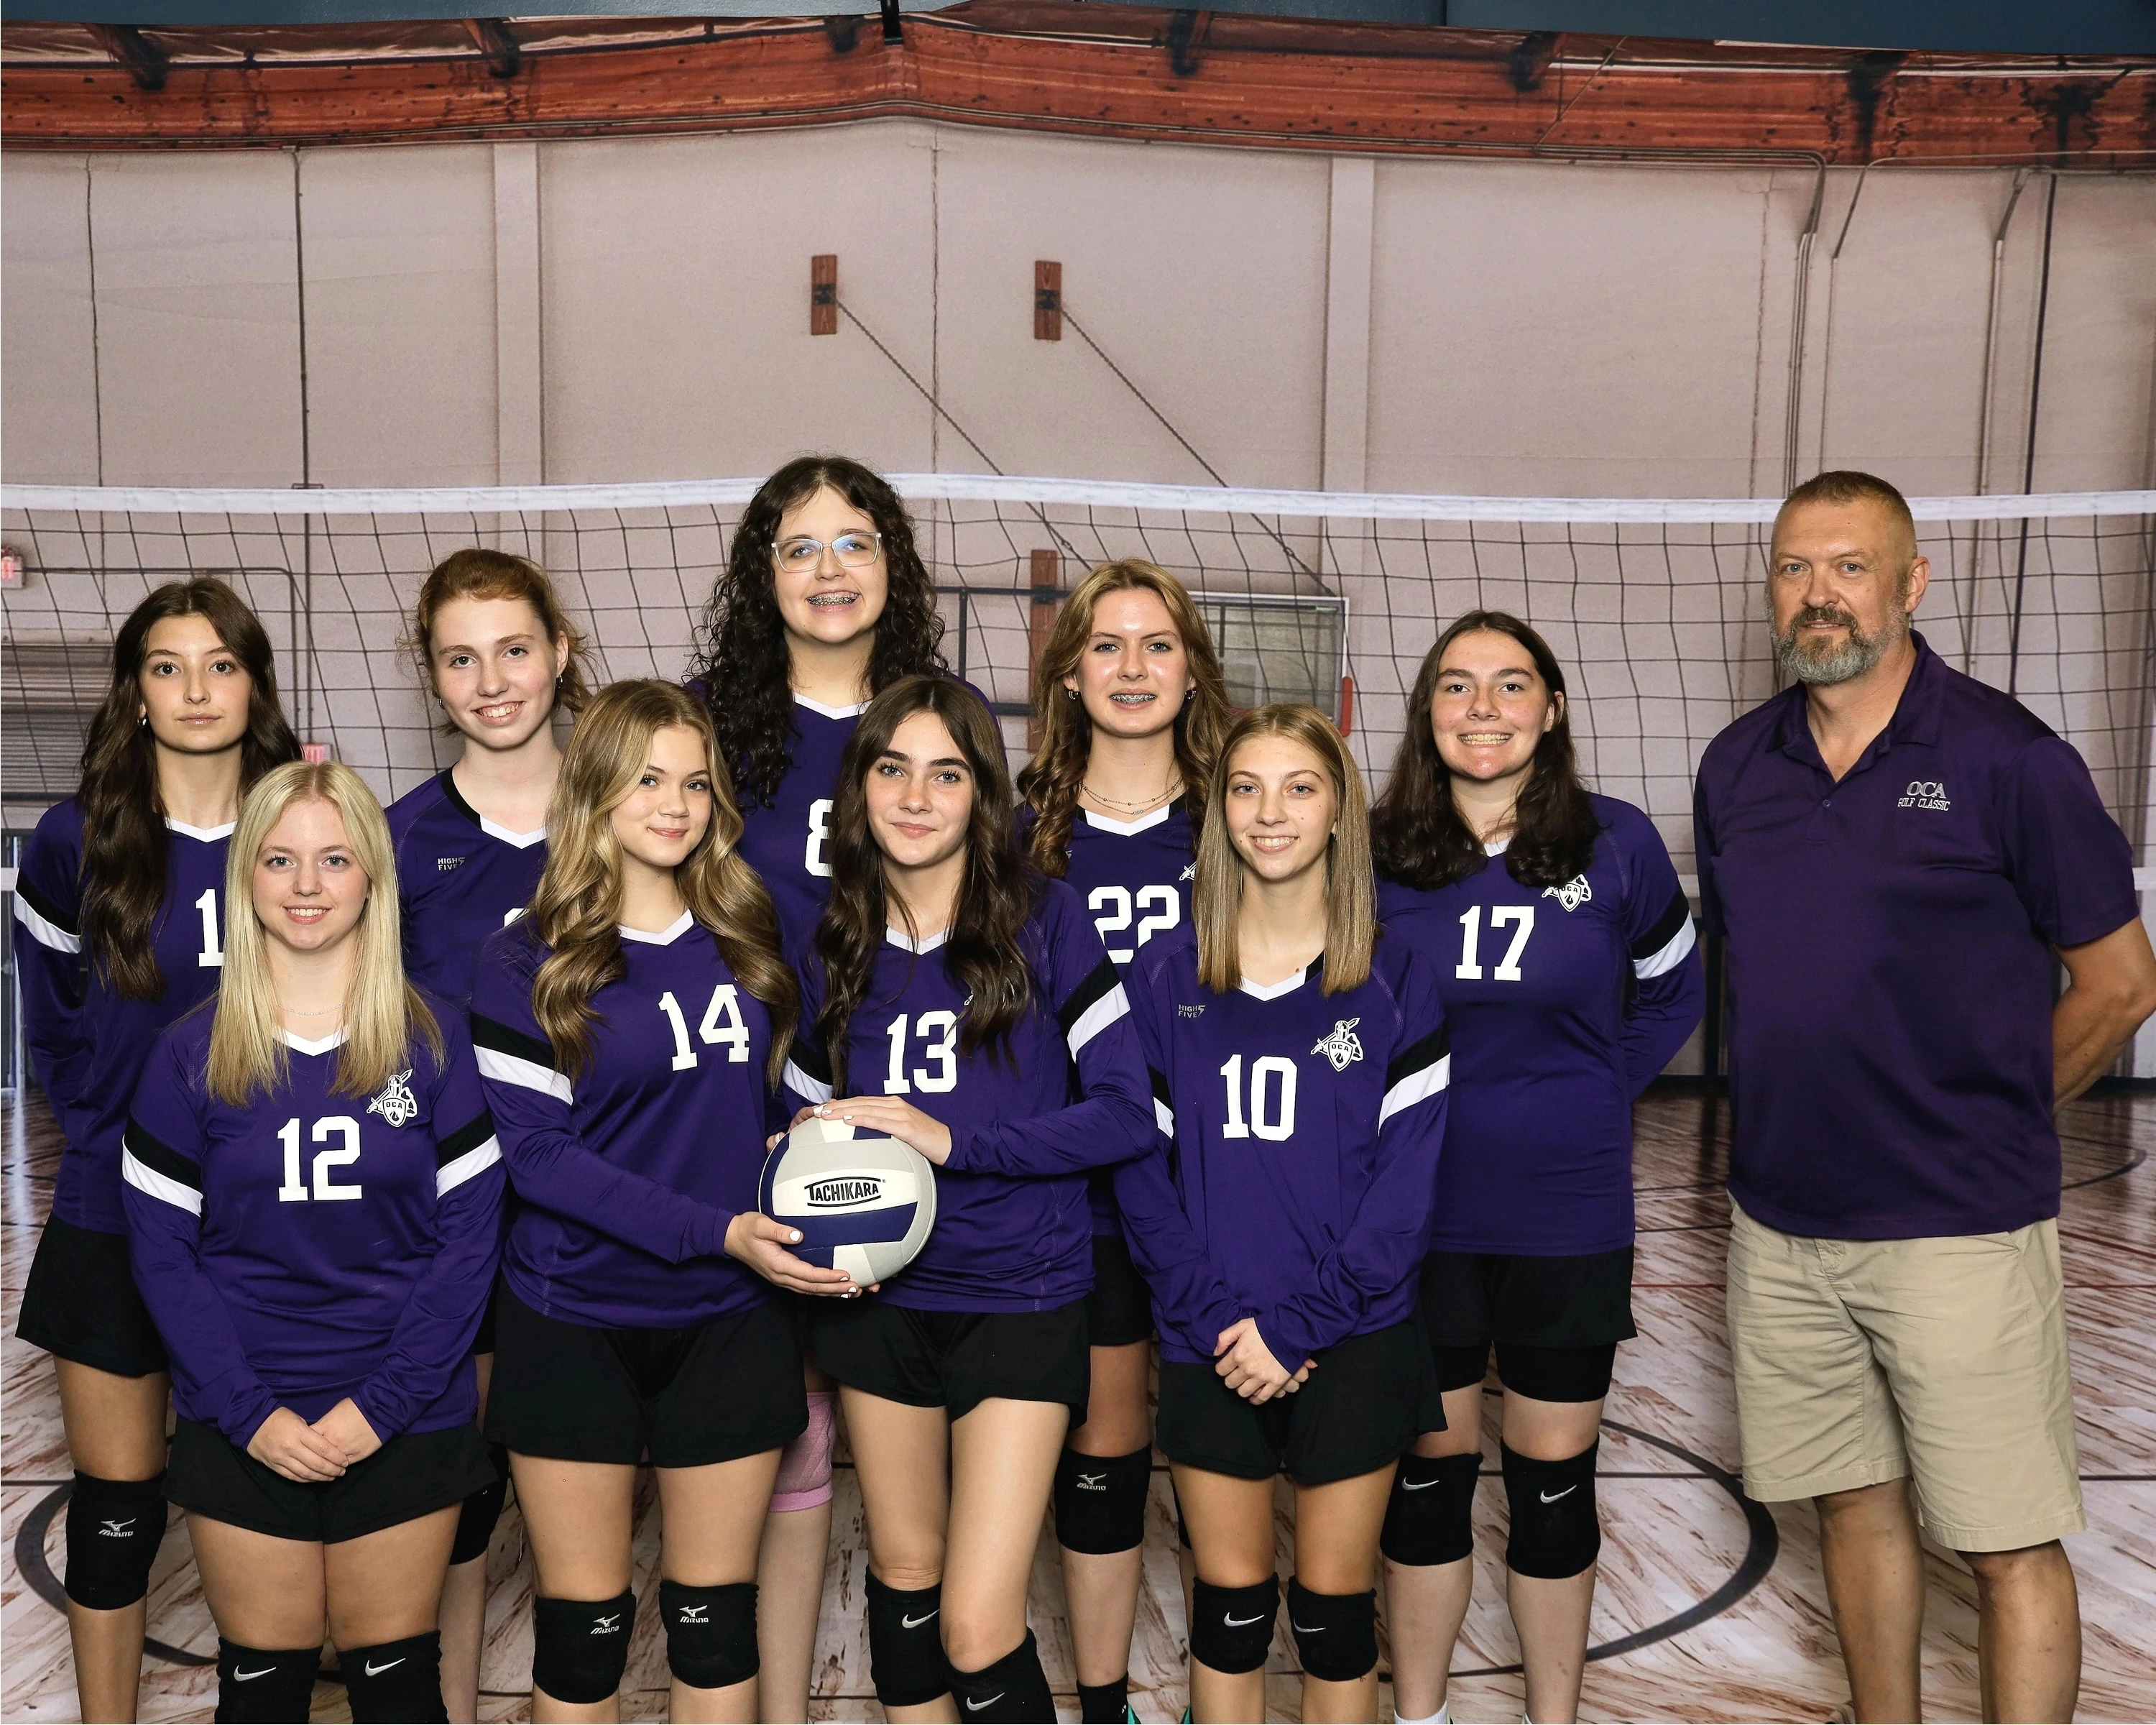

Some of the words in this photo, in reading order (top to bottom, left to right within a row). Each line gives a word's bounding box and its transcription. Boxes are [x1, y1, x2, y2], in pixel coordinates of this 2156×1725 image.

[1906, 781, 1947, 799] OCA
[1917, 798, 1950, 811] CLASSIC
[1087, 884, 1181, 964] 22
[1455, 904, 1535, 981] 17
[657, 983, 750, 1072] 14
[1179, 1003, 1197, 1012] HIGH
[883, 1010, 958, 1095] 13
[1219, 1053, 1298, 1142] 10
[277, 1115, 362, 1202] 12
[804, 1182, 879, 1202] TACHIKARA
